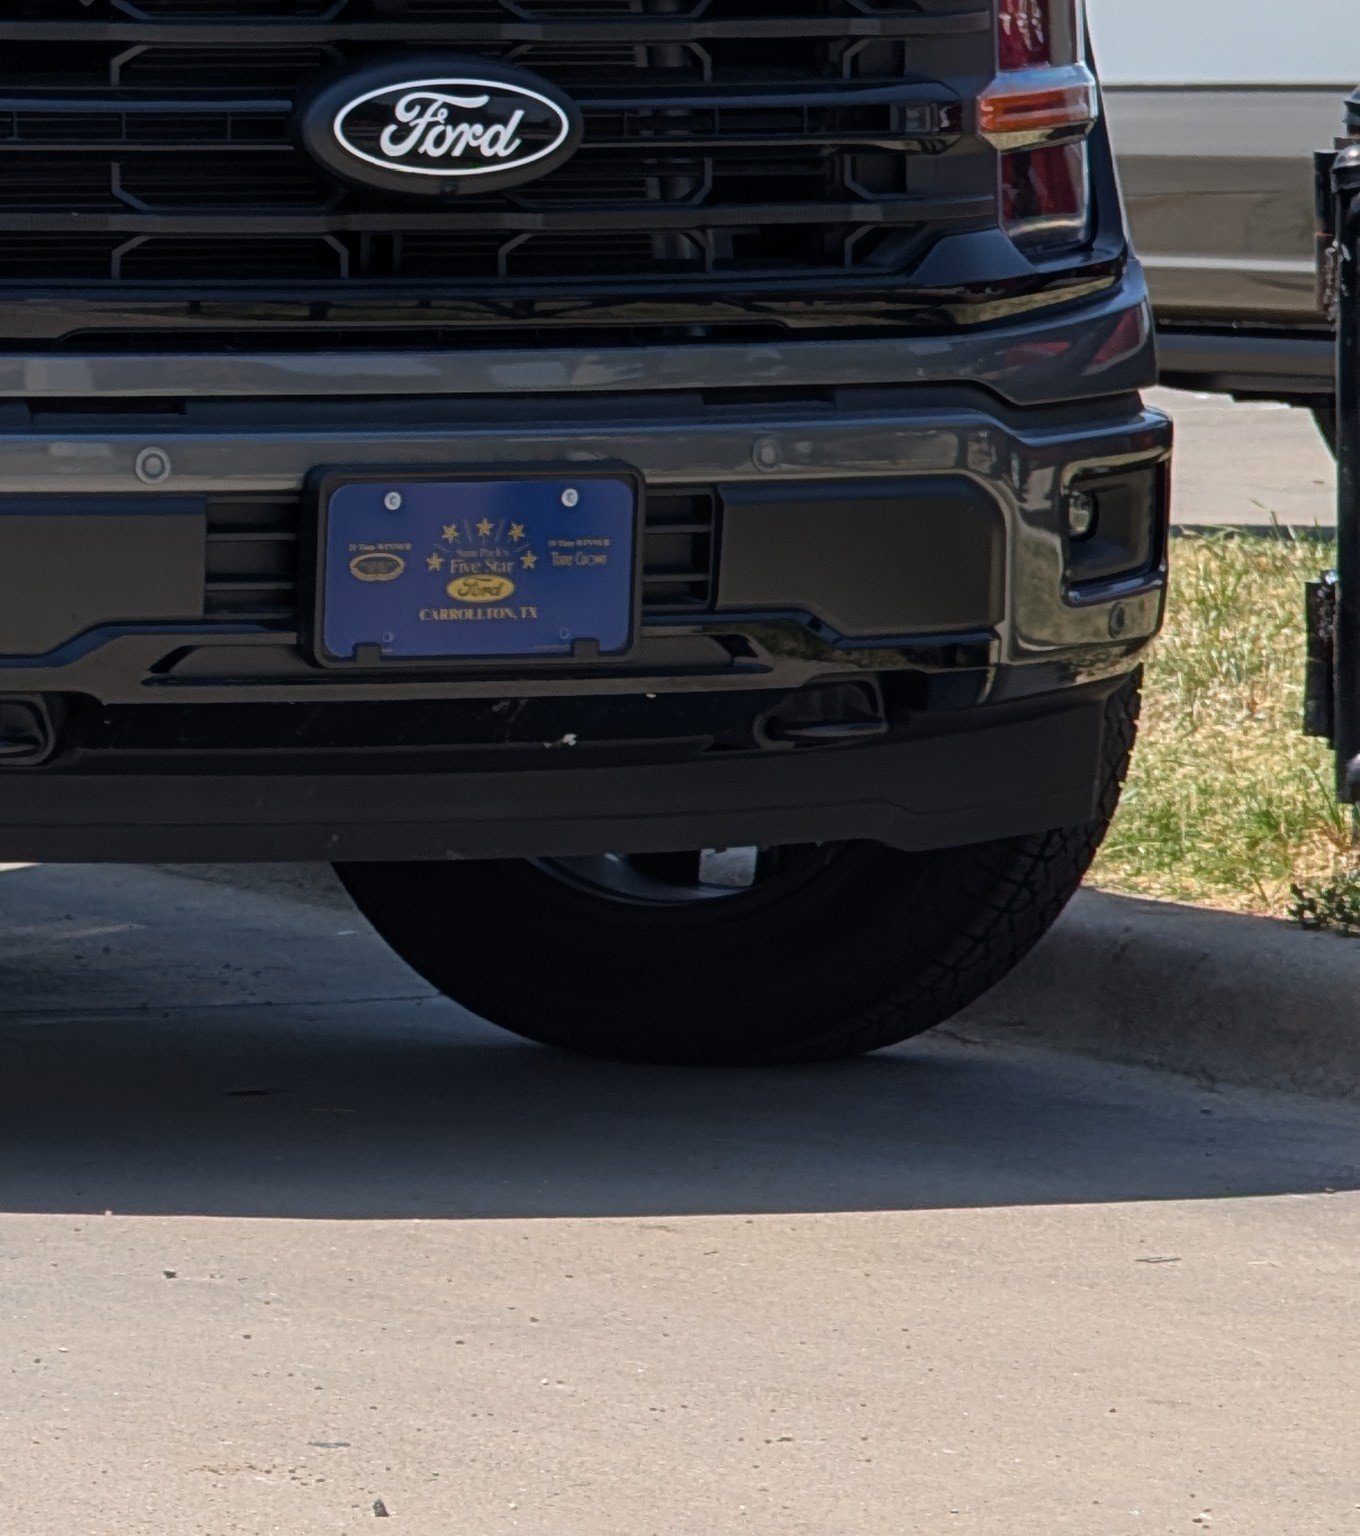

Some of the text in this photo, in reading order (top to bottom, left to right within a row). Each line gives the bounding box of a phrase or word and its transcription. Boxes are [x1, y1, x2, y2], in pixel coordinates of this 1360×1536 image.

[380, 91, 525, 158] Ford
[449, 559, 516, 574] Five Star
[457, 577, 505, 597] Ford
